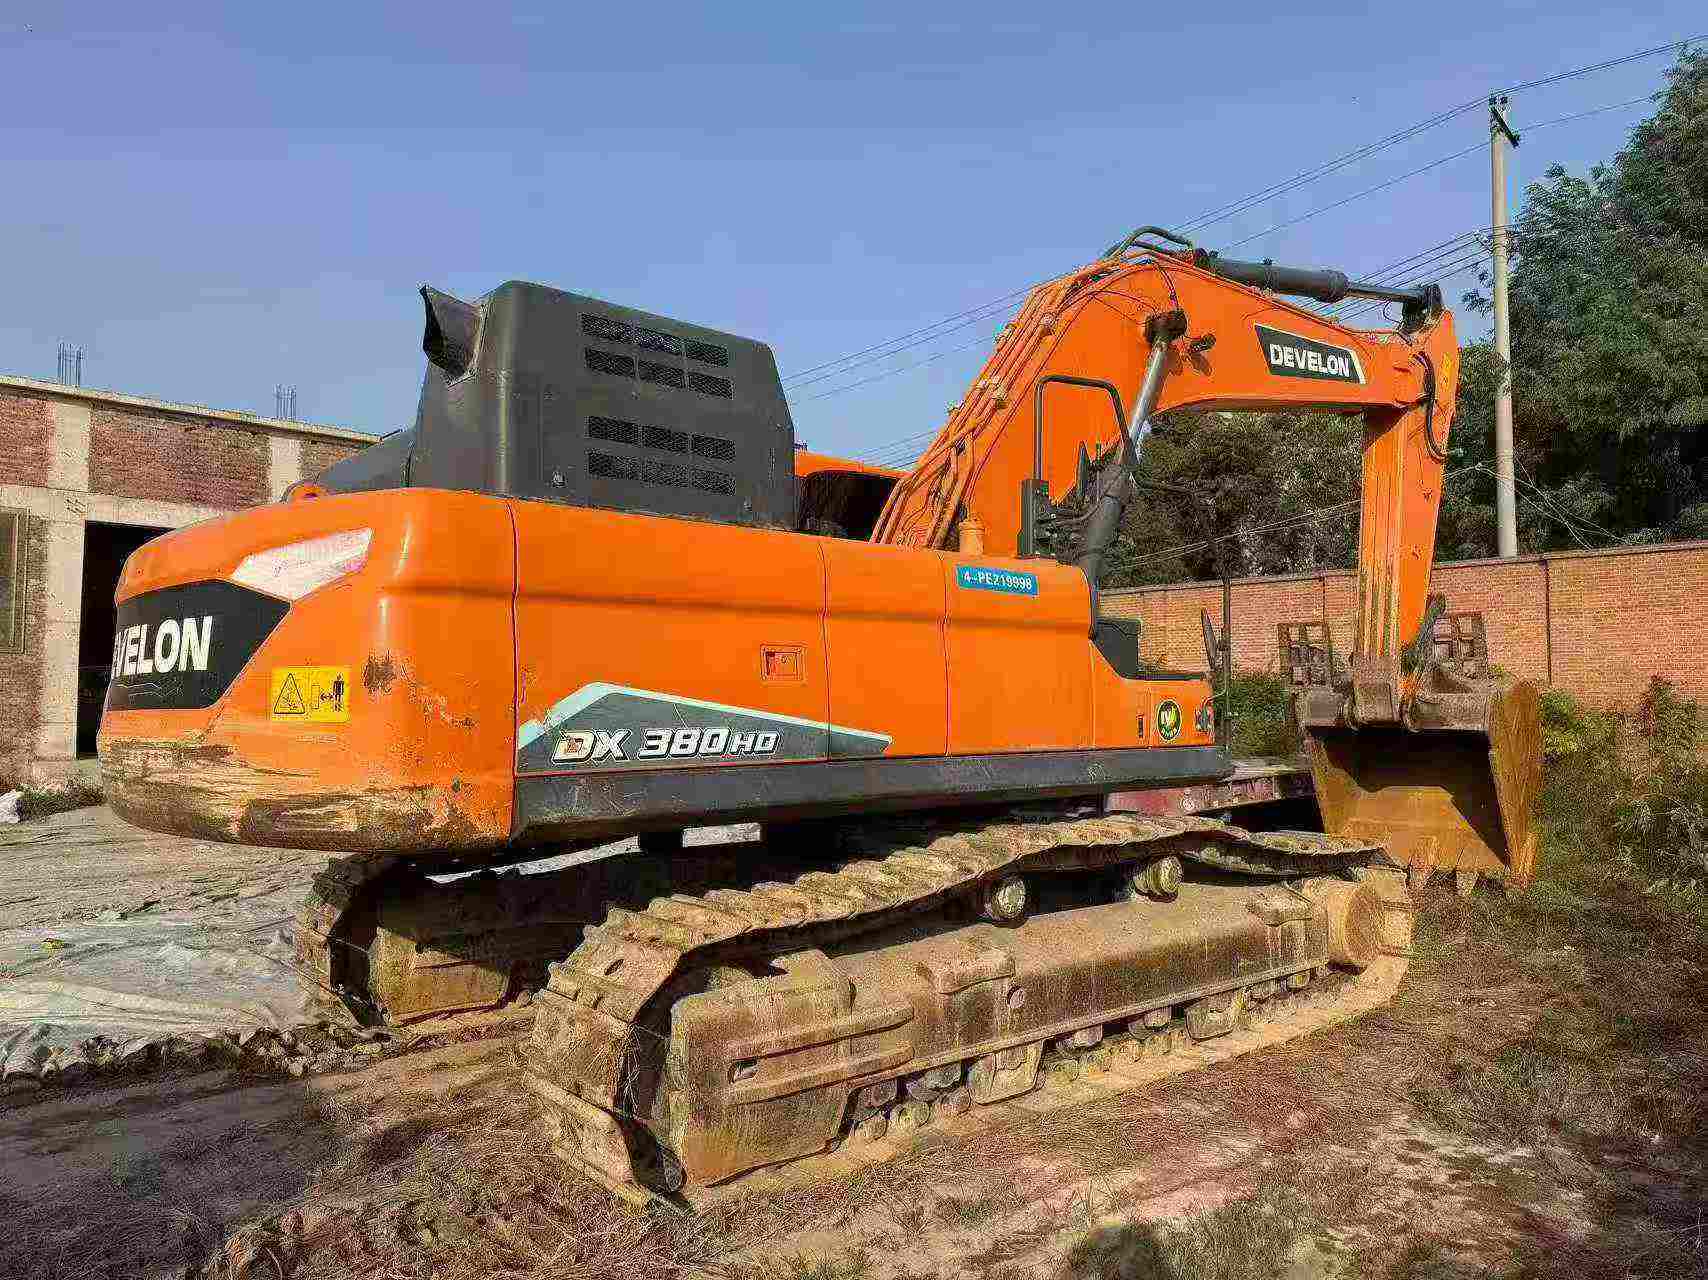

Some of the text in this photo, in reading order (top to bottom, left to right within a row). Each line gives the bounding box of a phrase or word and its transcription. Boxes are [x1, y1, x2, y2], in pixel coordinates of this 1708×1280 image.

[1269, 343, 1350, 377] DEVELON
[111, 615, 213, 679] VELON
[552, 729, 632, 763] DX
